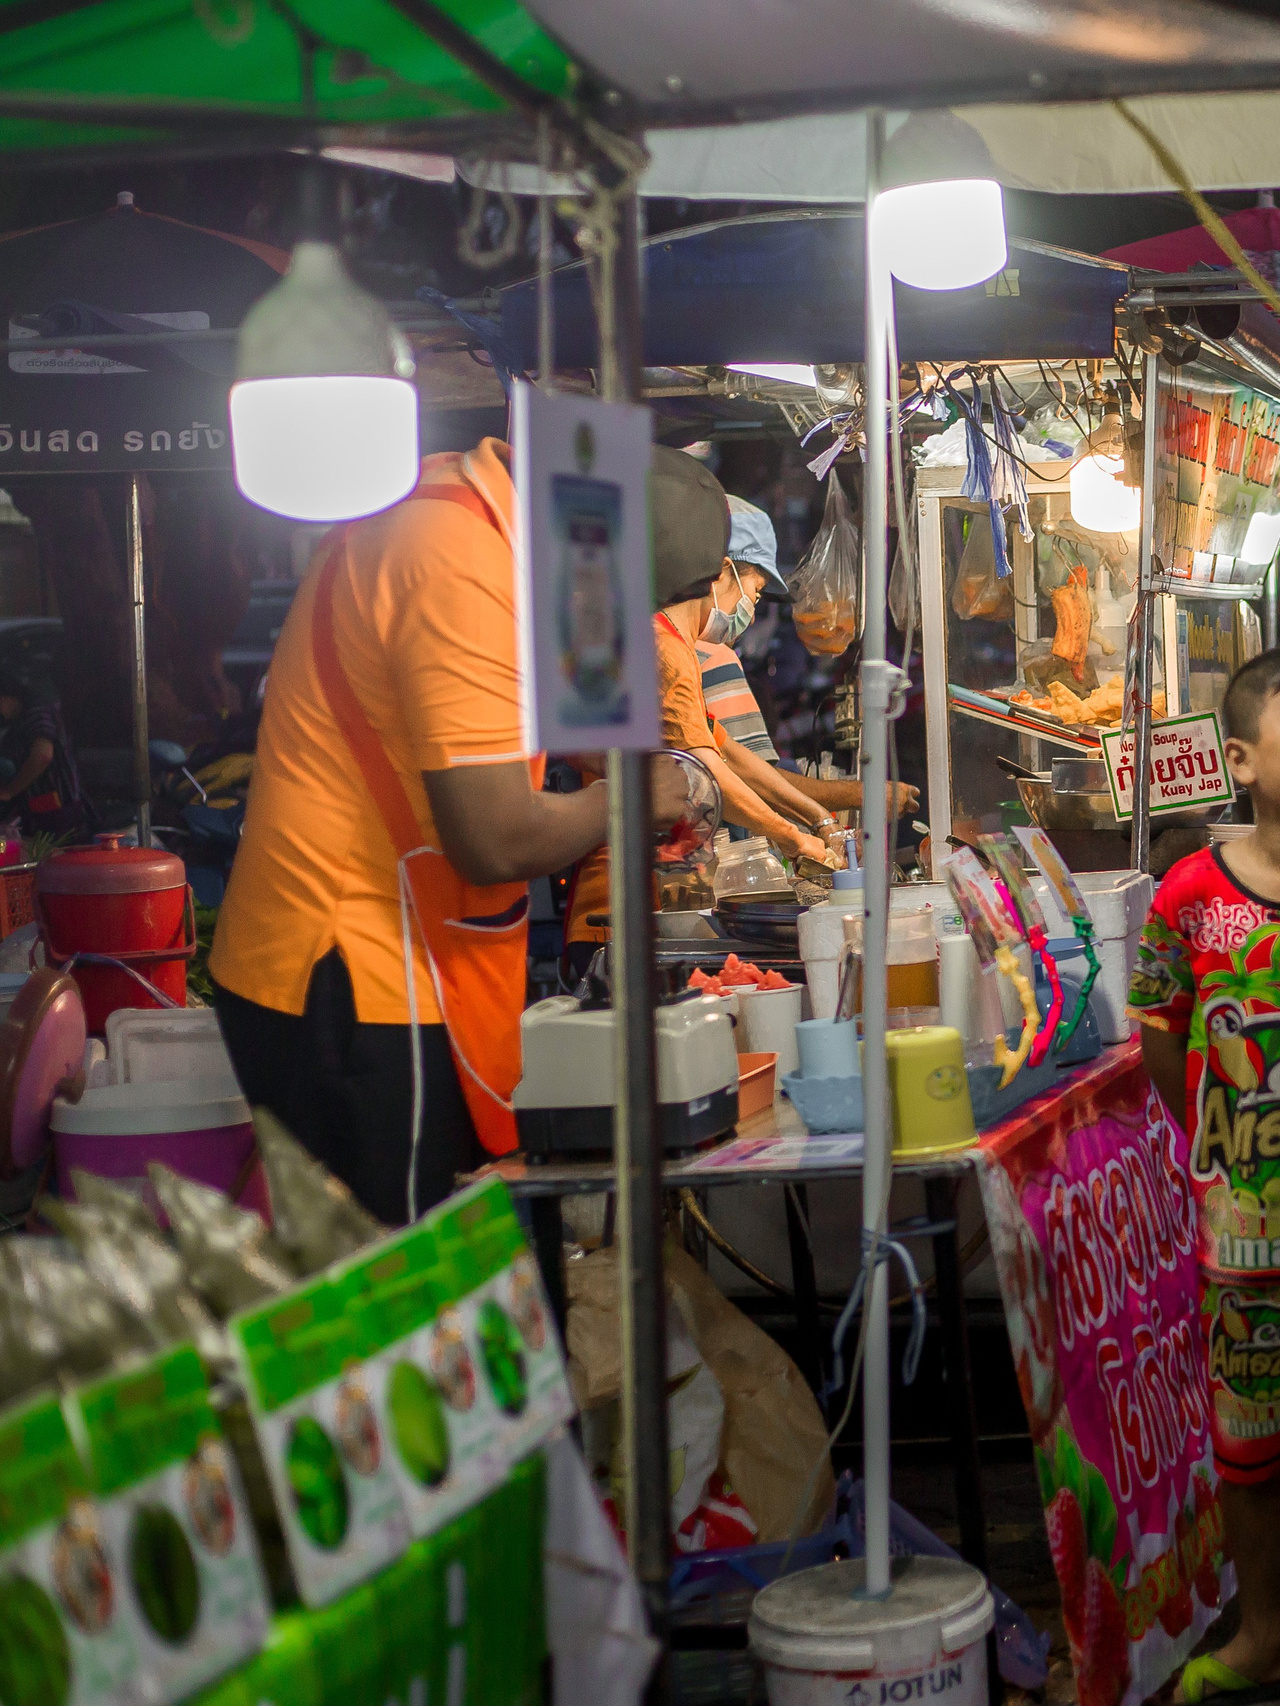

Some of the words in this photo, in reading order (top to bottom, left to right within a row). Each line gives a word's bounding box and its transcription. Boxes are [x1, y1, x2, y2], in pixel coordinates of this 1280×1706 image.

[1153, 733, 1178, 746] Soup
[1116, 737, 1218, 791] ก๋ยจั๊บ
[1160, 783, 1193, 798] Kuay
[1198, 778, 1222, 791] Jap
[879, 1663, 962, 1706] JOTUN
